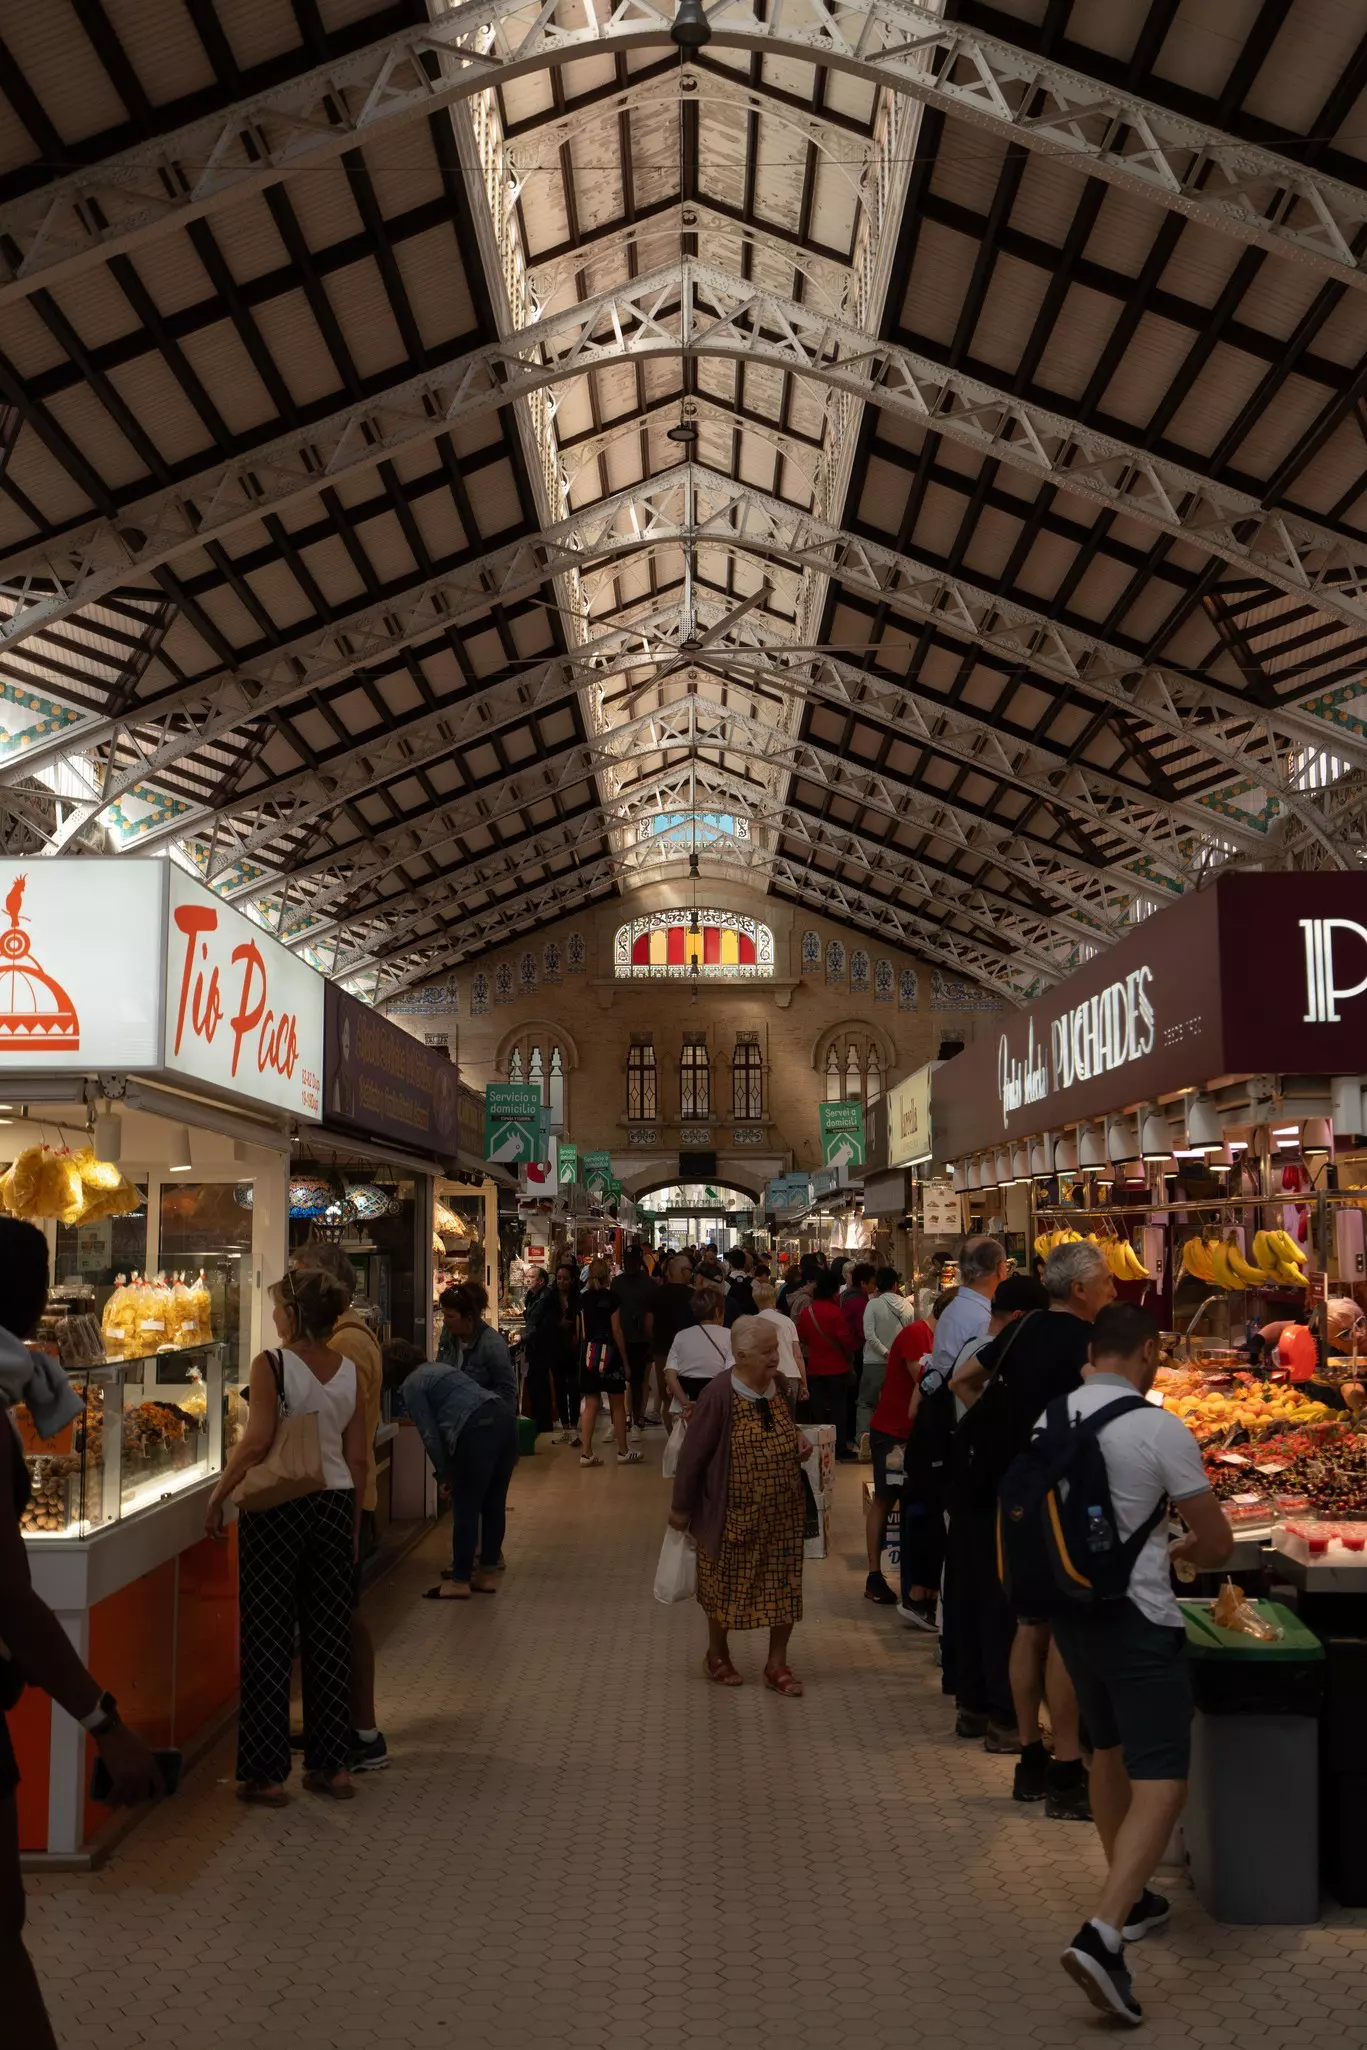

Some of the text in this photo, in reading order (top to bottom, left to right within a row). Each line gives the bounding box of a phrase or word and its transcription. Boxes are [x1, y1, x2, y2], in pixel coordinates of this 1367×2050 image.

[174, 905, 223, 1056] Tio
[231, 937, 299, 1080] Paco
[1051, 966, 1154, 1092] PUCHADES
[490, 1091, 529, 1102] Servicio
[490, 1104, 536, 1114] domicilio
[825, 1108, 850, 1118] Servei
[826, 1117, 857, 1128] domicili
